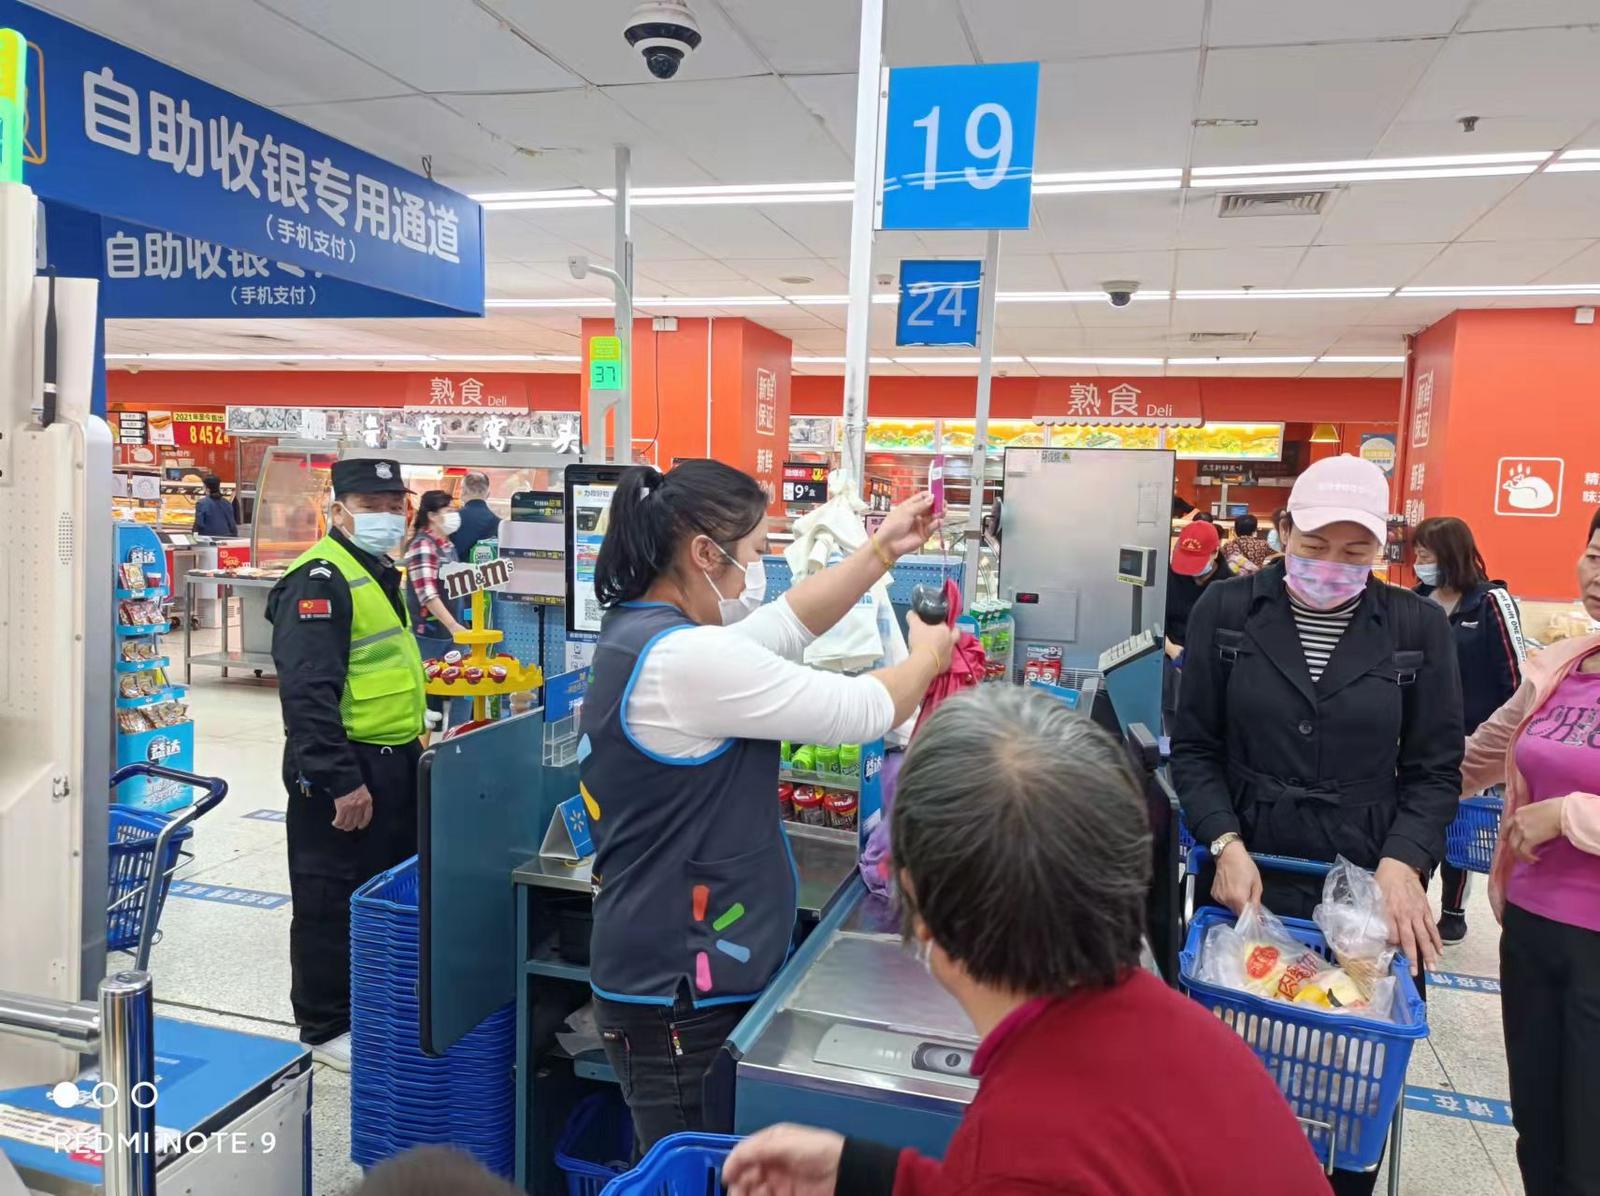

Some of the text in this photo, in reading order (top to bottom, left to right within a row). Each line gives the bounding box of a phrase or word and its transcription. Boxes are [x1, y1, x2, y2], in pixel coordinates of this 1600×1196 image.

[83, 66, 461, 264] 自助收银专用通道
[912, 102, 1014, 190] 19
[106, 231, 323, 280] 自助收银
[907, 280, 967, 327] 24
[429, 377, 507, 407] 熟食 Deli
[595, 365, 616, 383] 37
[1067, 382, 1173, 417] 熟食 Deli
